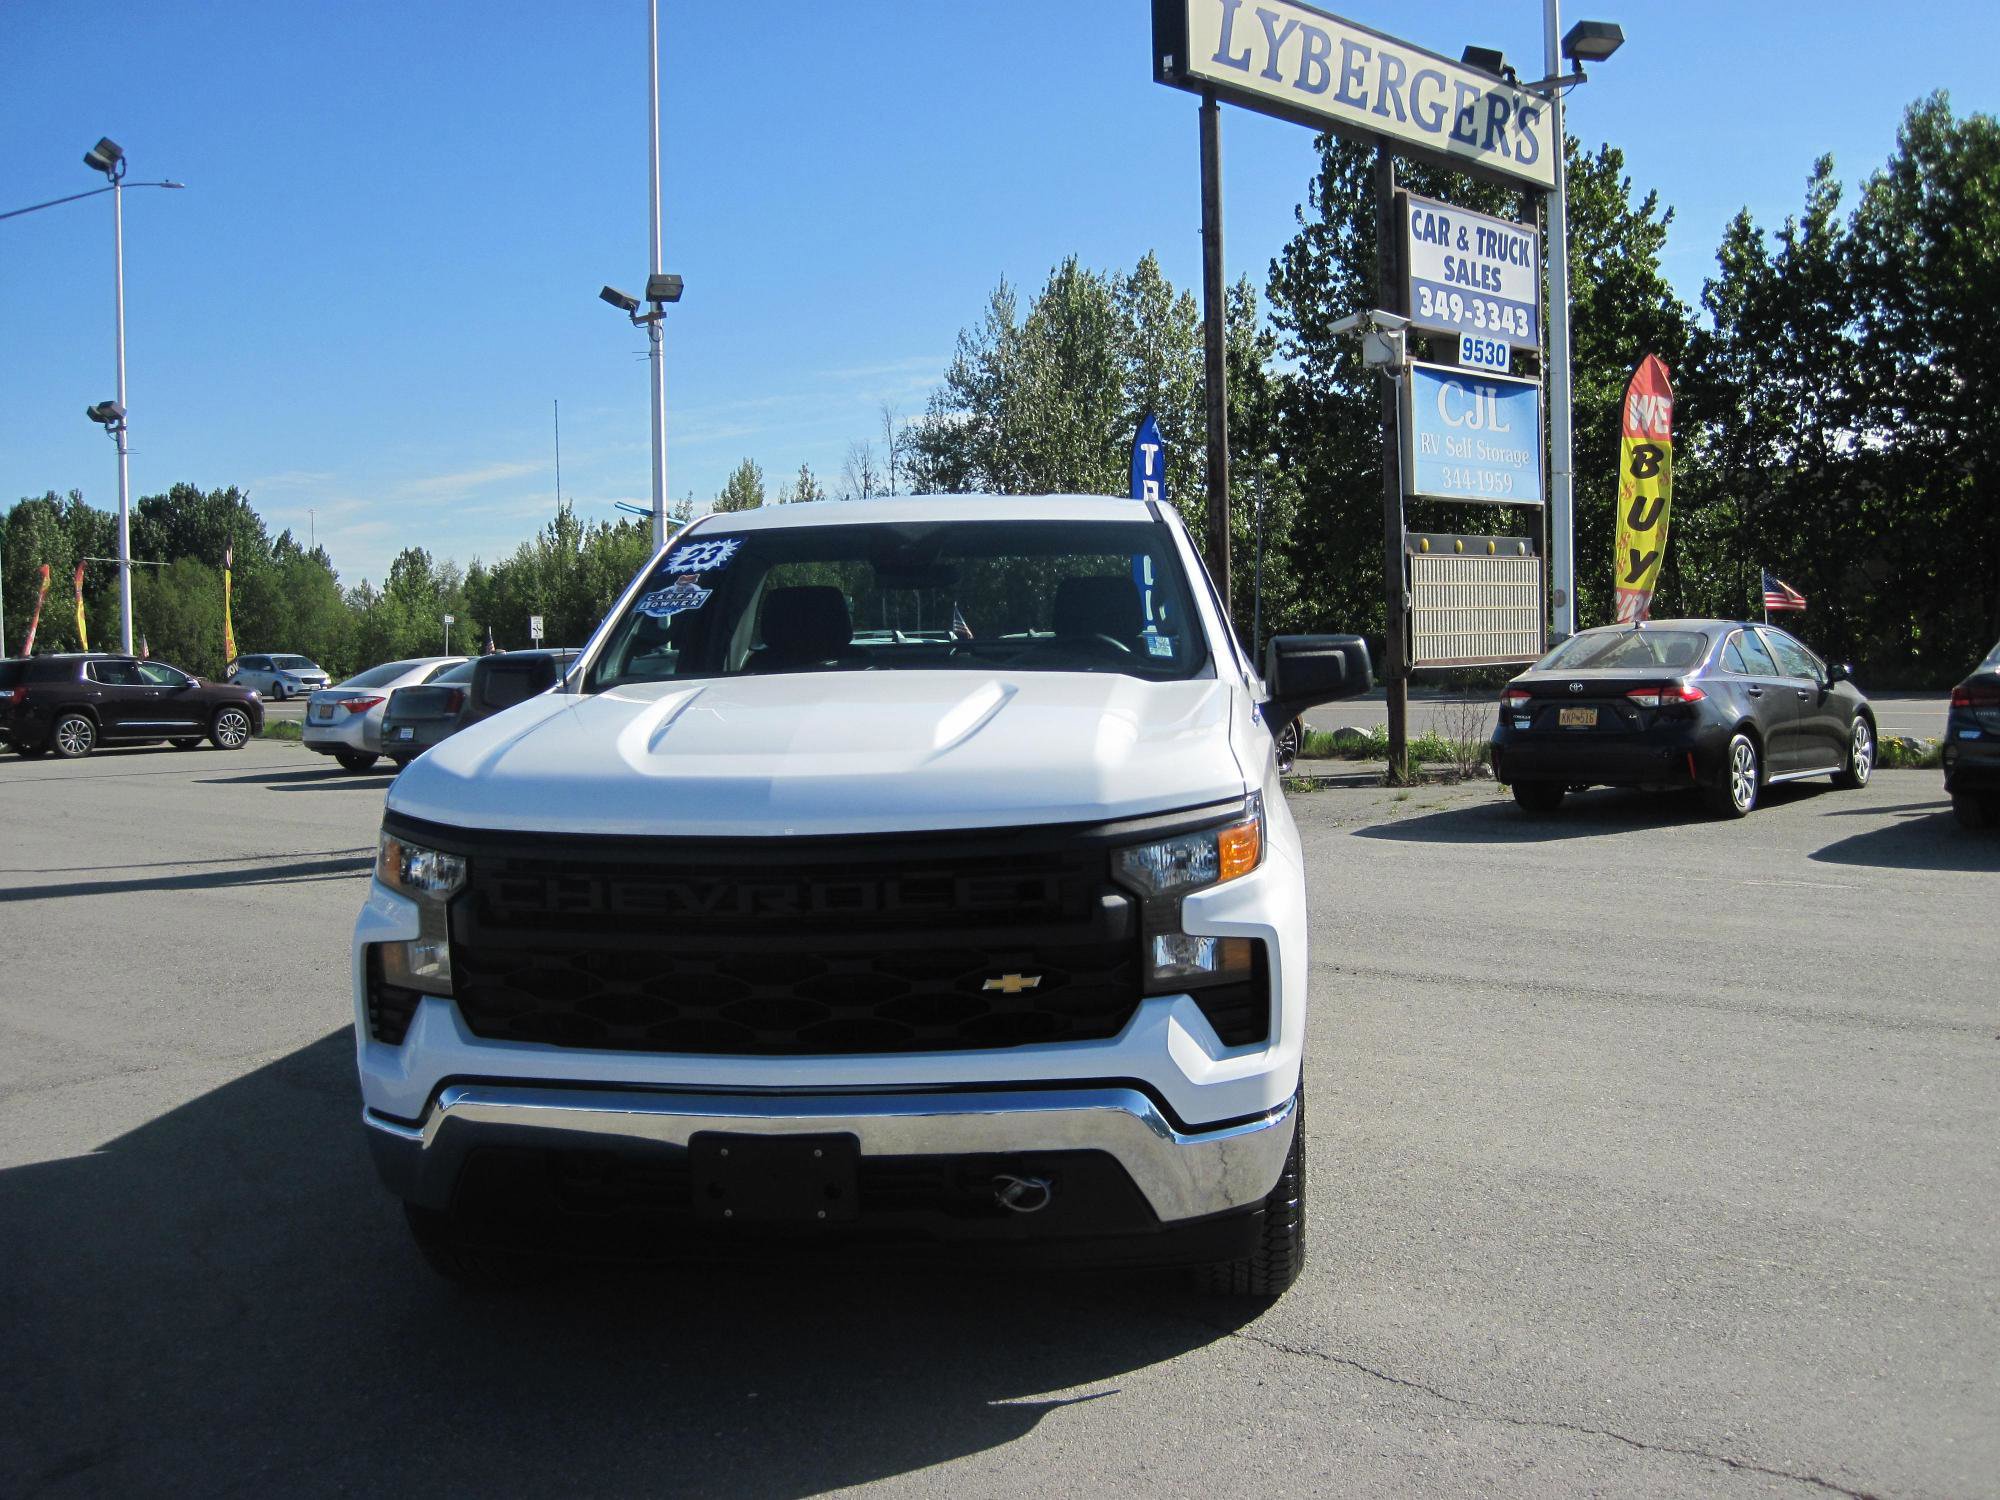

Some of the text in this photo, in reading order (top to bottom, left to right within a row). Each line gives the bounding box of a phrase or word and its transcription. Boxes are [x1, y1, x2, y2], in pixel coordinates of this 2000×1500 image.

[1212, 0, 1541, 167] LYBERGER'S
[1411, 209, 1530, 268] CAR & TRUCK
[1443, 255, 1502, 293] SALES
[1418, 286, 1529, 338] 349-3343
[1462, 337, 1506, 367] 9530
[1437, 380, 1511, 433] CJL
[1629, 393, 1672, 434] WE
[1420, 432, 1530, 468] RV Self Storage
[1442, 466, 1513, 494] 344-1959
[1624, 443, 1665, 584] BUY
[677, 545, 724, 567] 23
[651, 600, 700, 609] OWNER
[488, 872, 1086, 915] CHEVROLET
